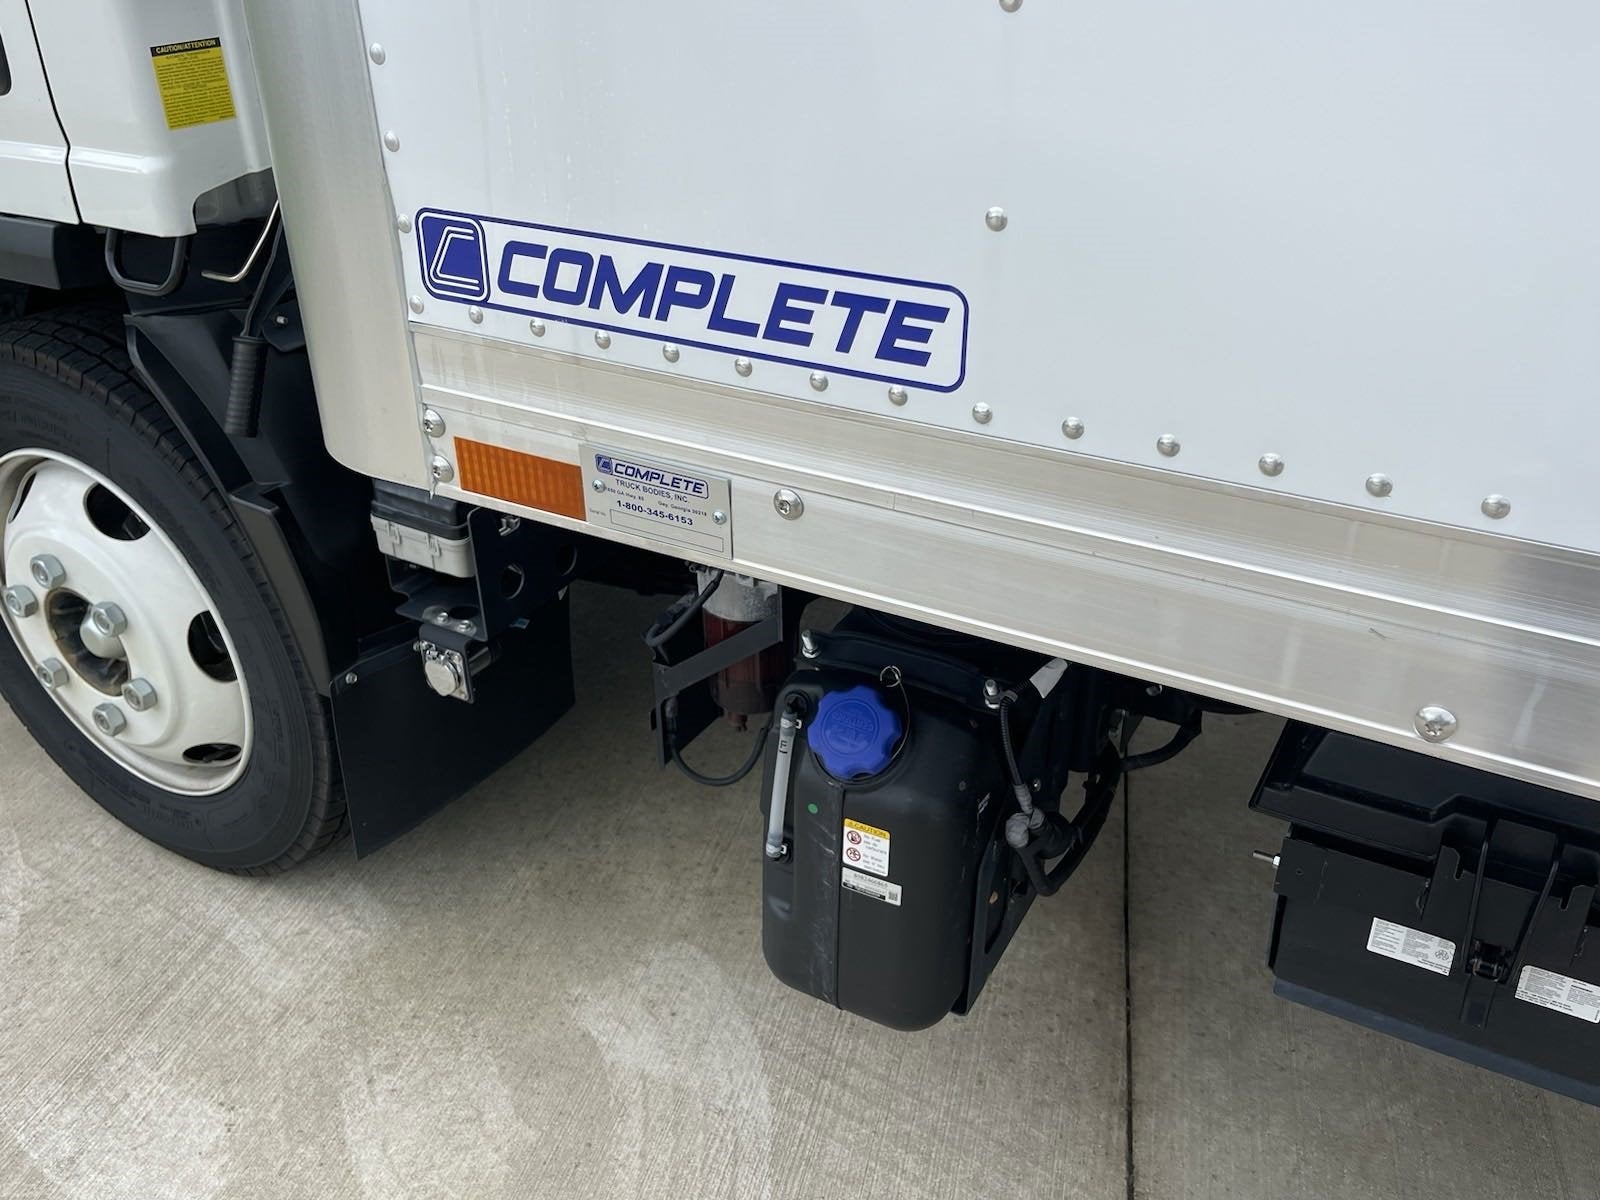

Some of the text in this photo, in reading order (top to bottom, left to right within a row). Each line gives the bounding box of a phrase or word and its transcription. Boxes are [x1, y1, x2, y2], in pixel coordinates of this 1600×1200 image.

[497, 239, 950, 367] COMPLETE
[614, 462, 705, 494] COMPLETE
[615, 479, 690, 503] TRUCK BODIES, INC.
[616, 500, 694, 526] 1-800-345-6153
[854, 822, 887, 837] CAUTION
